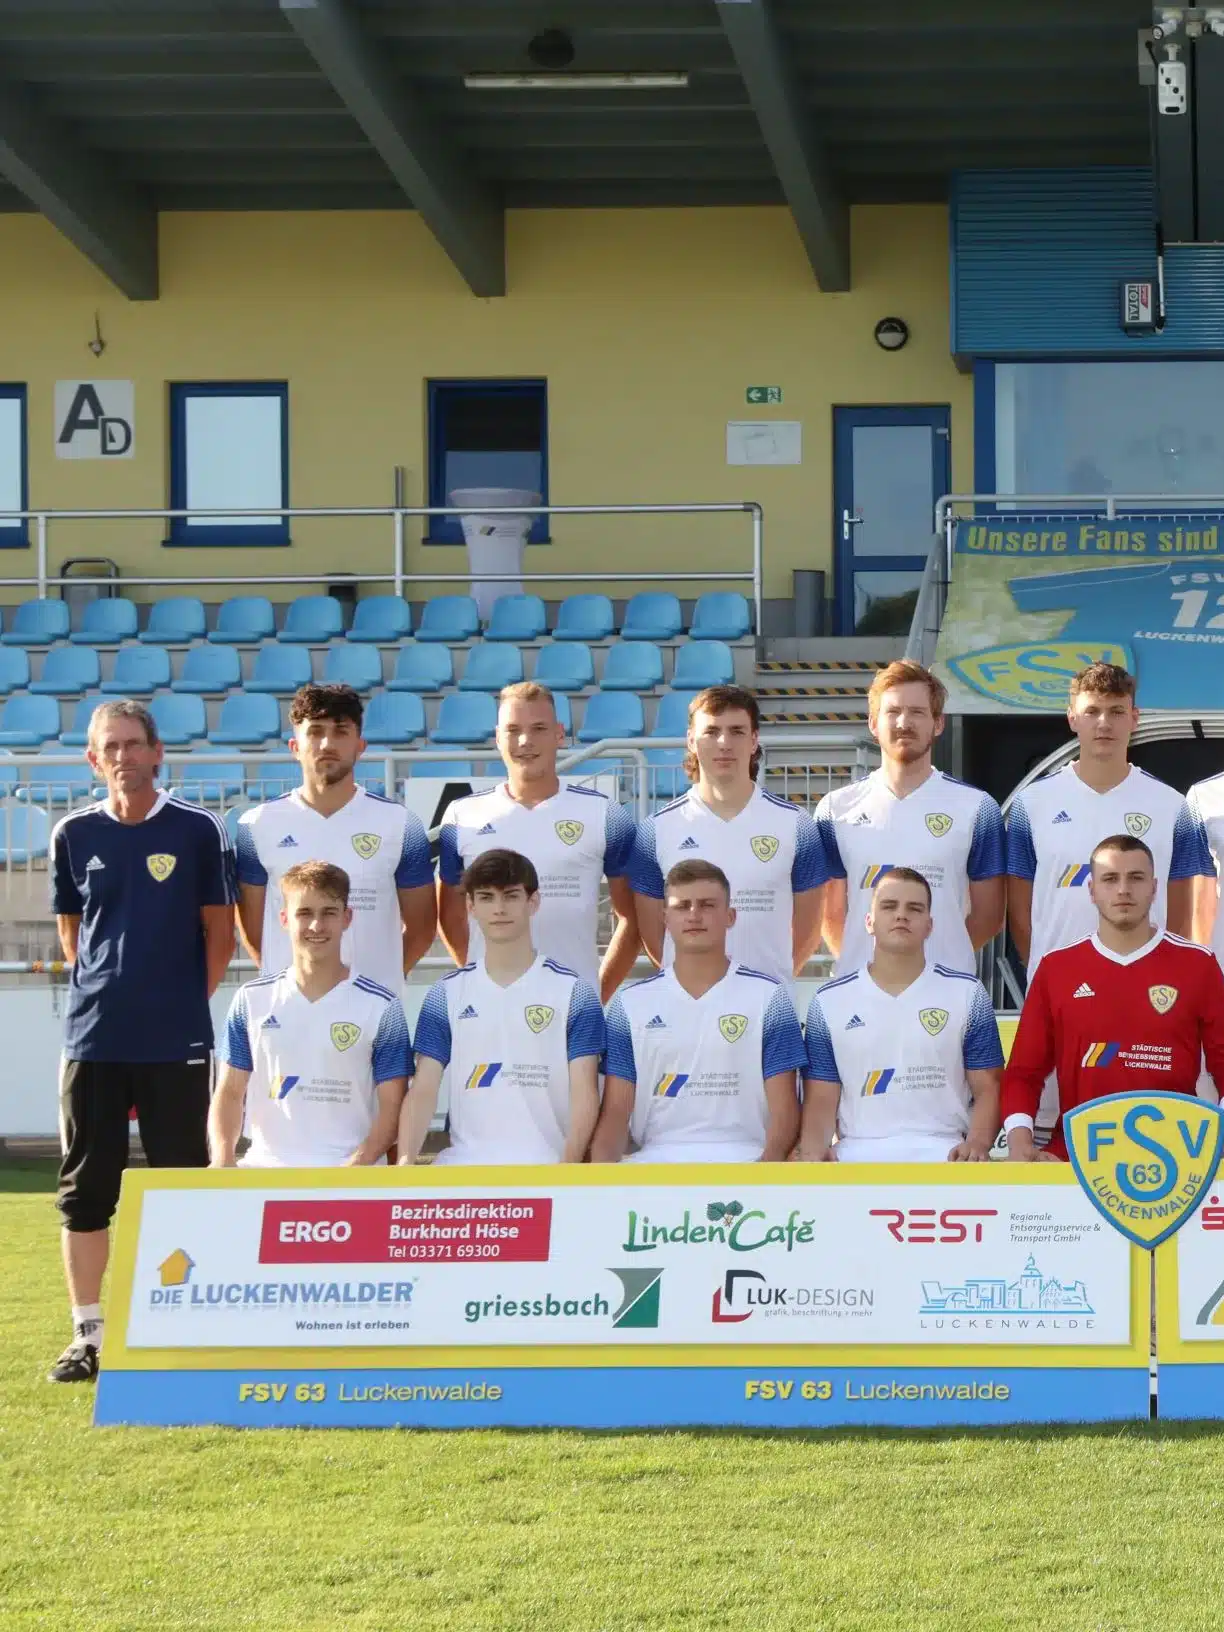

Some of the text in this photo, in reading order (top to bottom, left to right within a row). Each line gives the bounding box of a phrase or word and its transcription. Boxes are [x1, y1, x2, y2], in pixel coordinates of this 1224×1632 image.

[967, 525, 1068, 552] Unsere
[1078, 523, 1147, 552] Fans
[1158, 524, 1219, 552] sind
[1131, 1044, 1172, 1054] STÄDTISCHE
[1088, 1104, 1210, 1202] FSV
[1132, 1163, 1162, 1184] 63
[1092, 1173, 1203, 1220] LUCKENWALDE
[391, 1204, 534, 1221] Bezirksdirektion
[1010, 1212, 1052, 1223] Regionale
[279, 1221, 352, 1243] ERGO
[390, 1223, 520, 1241] Burkhard Höse
[869, 1209, 998, 1243] REST
[1010, 1223, 1101, 1234] Entsorgungsservice &
[1010, 1234, 1081, 1245] Transport GmbH
[388, 1244, 500, 1258] Tel 03371 69300
[150, 1282, 414, 1304] DIE LUCKENWALDER
[747, 1285, 874, 1307] LUK-DESIGN
[464, 1296, 609, 1322] griessbach
[295, 1320, 410, 1331] Wohnen ist erleben
[920, 1319, 1095, 1329] LUCKENWALDE
[239, 1382, 502, 1402] FSV 63 Luckenwalde
[746, 1380, 1010, 1400] FSV 63 Luckenwalde
